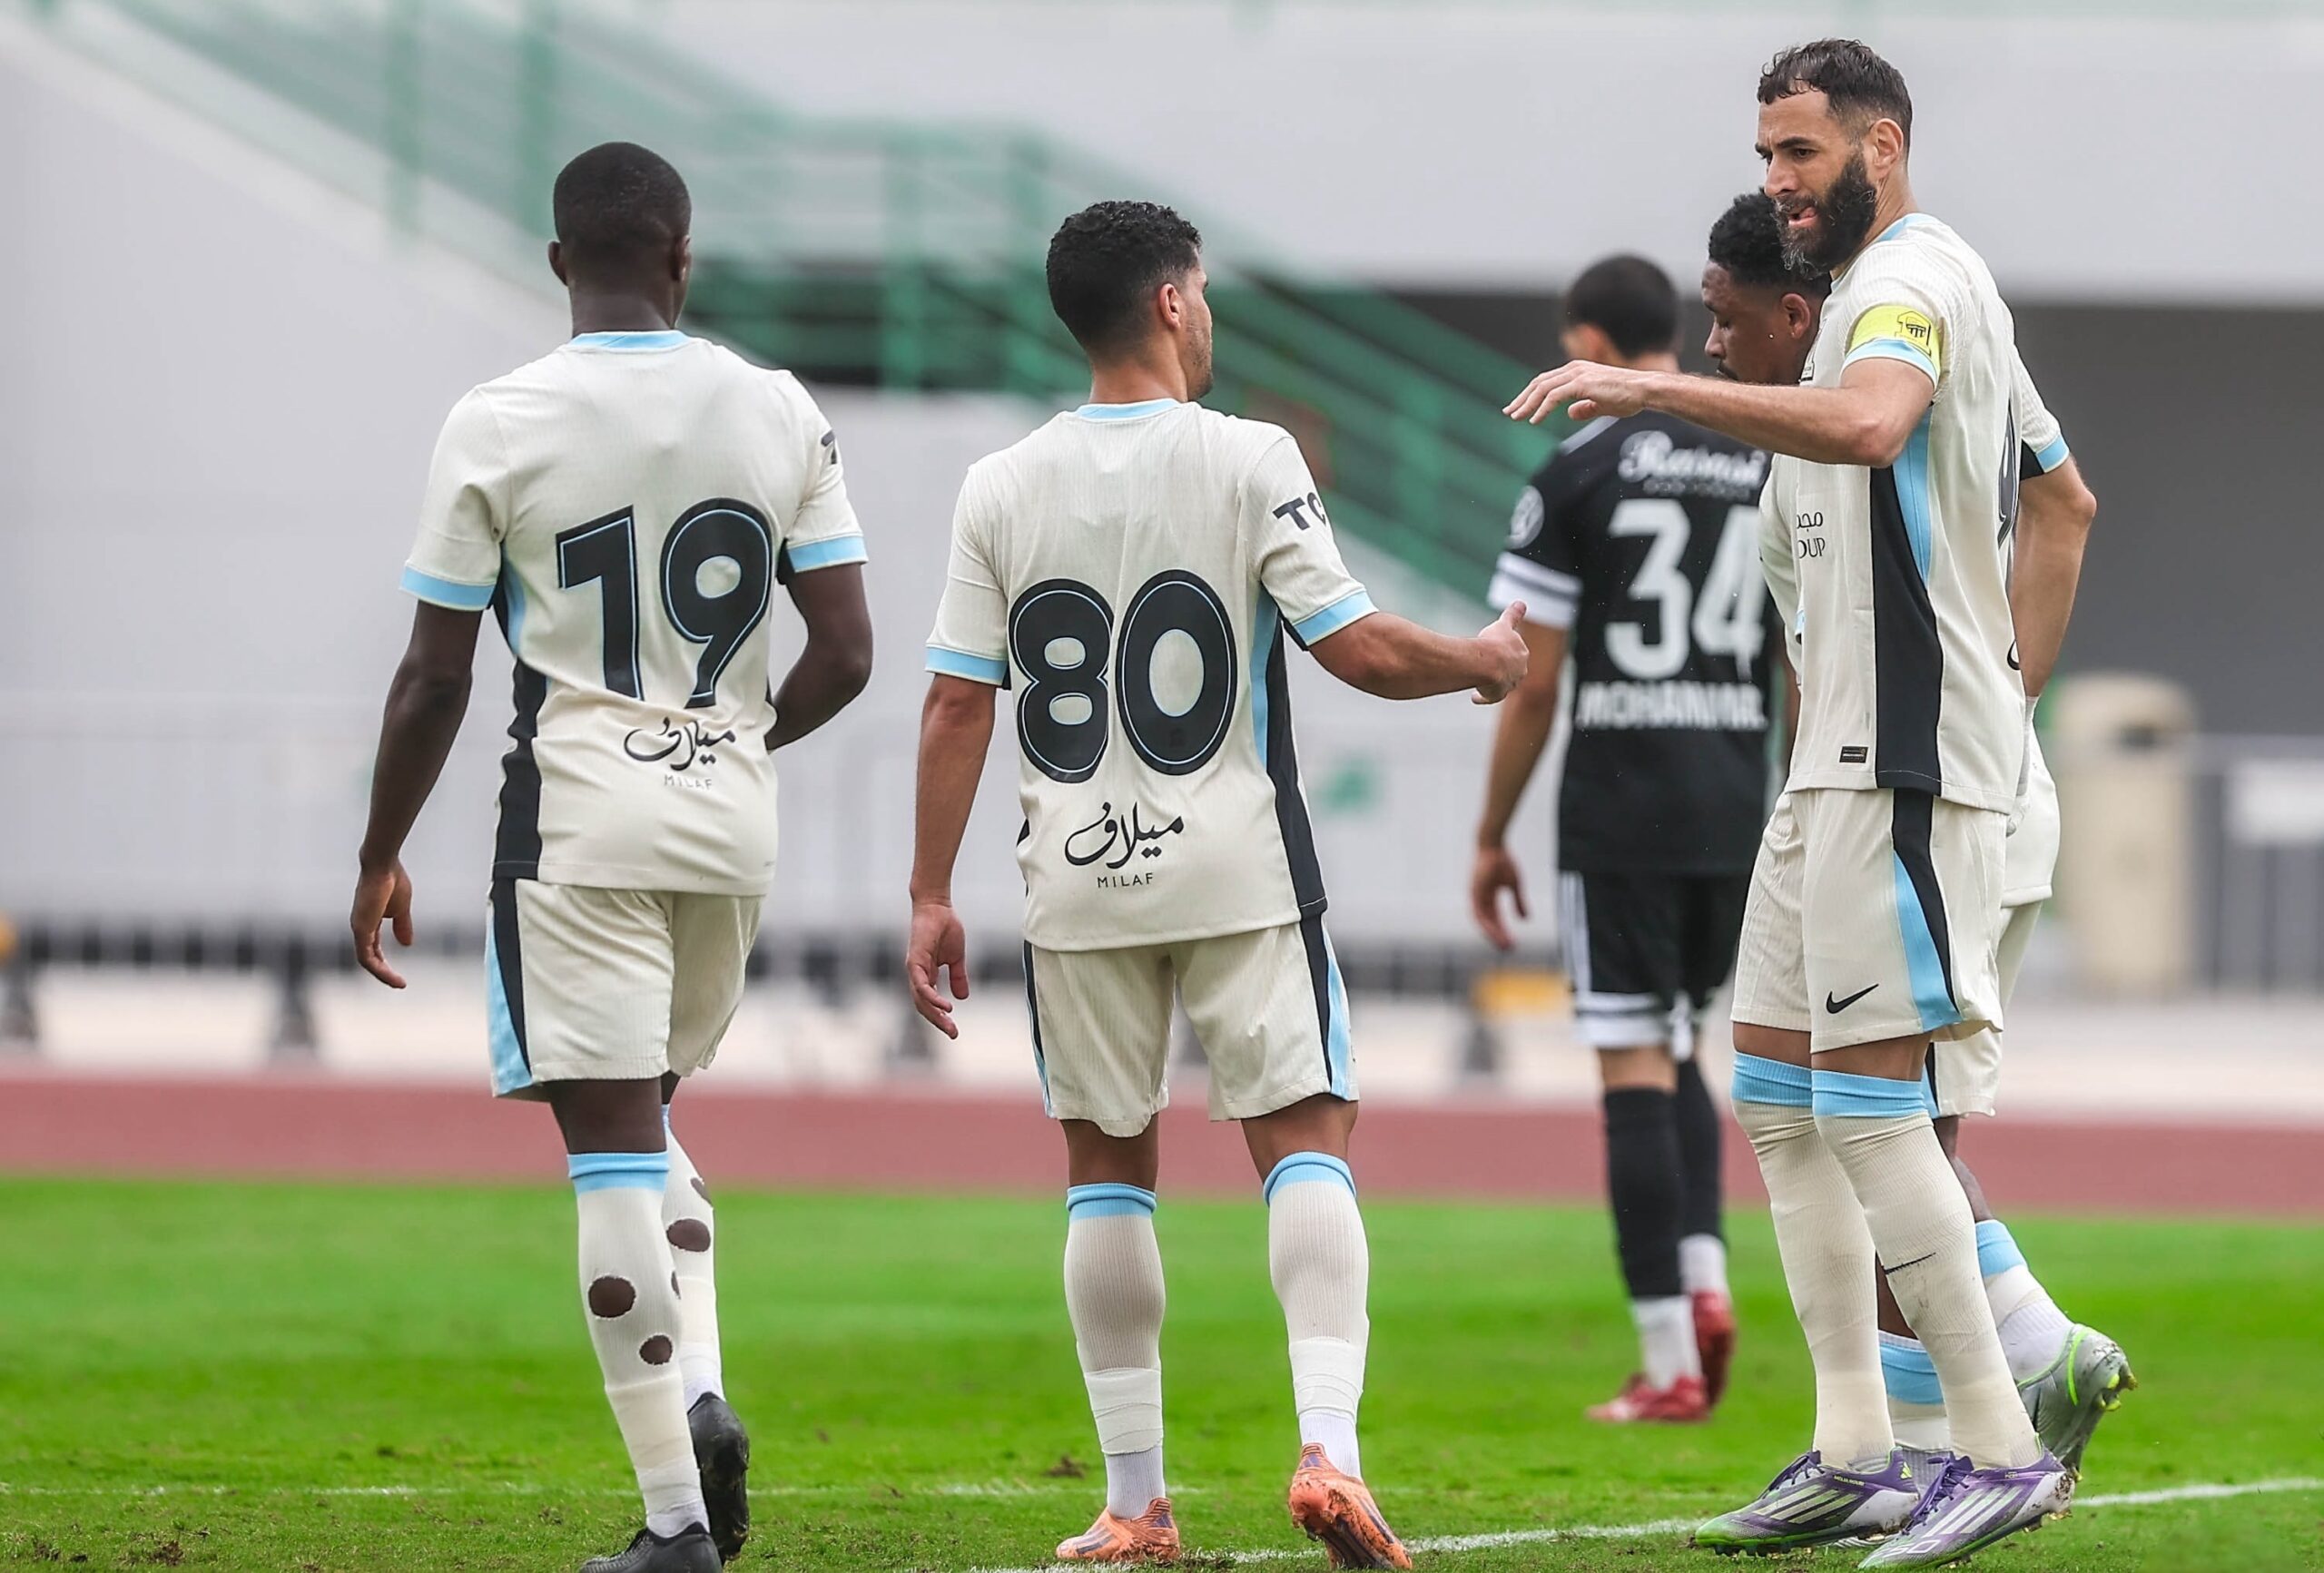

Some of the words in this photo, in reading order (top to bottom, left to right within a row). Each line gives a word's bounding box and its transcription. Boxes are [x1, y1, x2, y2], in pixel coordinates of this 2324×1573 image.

[556, 497, 773, 709] 19
[1604, 498, 1768, 681] 34
[1009, 569, 1237, 783] 80
[624, 717, 736, 772] ميلاف
[664, 773, 713, 791] MILAF
[1065, 801, 1184, 869] ميلاف
[1097, 872, 1154, 888] MILAF
